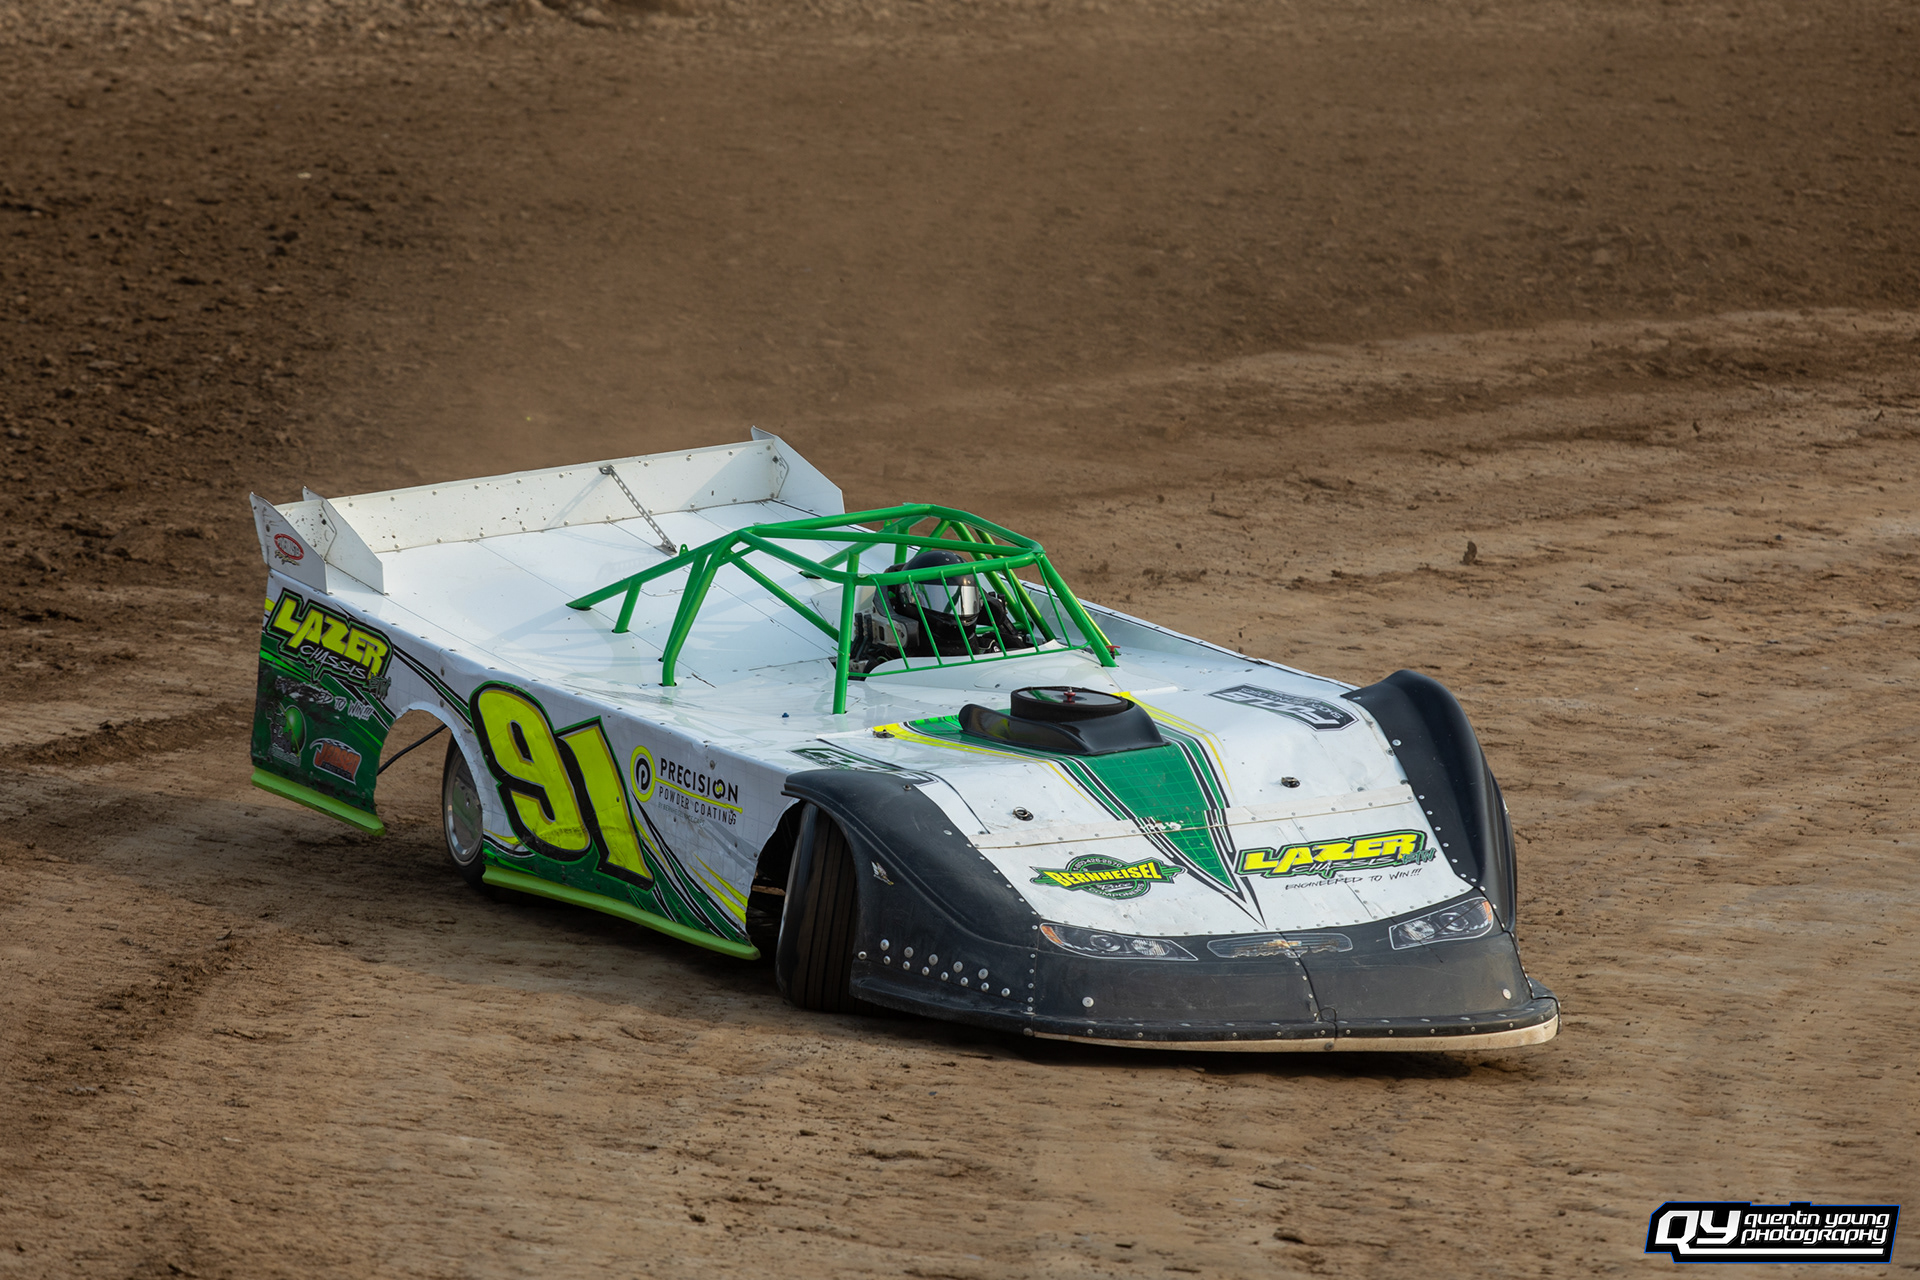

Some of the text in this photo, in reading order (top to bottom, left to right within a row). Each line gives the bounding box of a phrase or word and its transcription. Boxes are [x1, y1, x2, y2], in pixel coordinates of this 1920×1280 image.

[273, 597, 389, 680] LAZER
[300, 645, 367, 680] CHASSIS
[474, 685, 654, 884] 91
[660, 757, 739, 804] PRECISION
[658, 785, 690, 810] POWDER
[694, 801, 737, 825] COATING
[1043, 861, 1162, 887] BERNHEISEL
[1244, 834, 1417, 874] LAZER
[1293, 855, 1394, 877] CHASSIS
[1284, 867, 1423, 891] ENGINEERED TO WIN!!!
